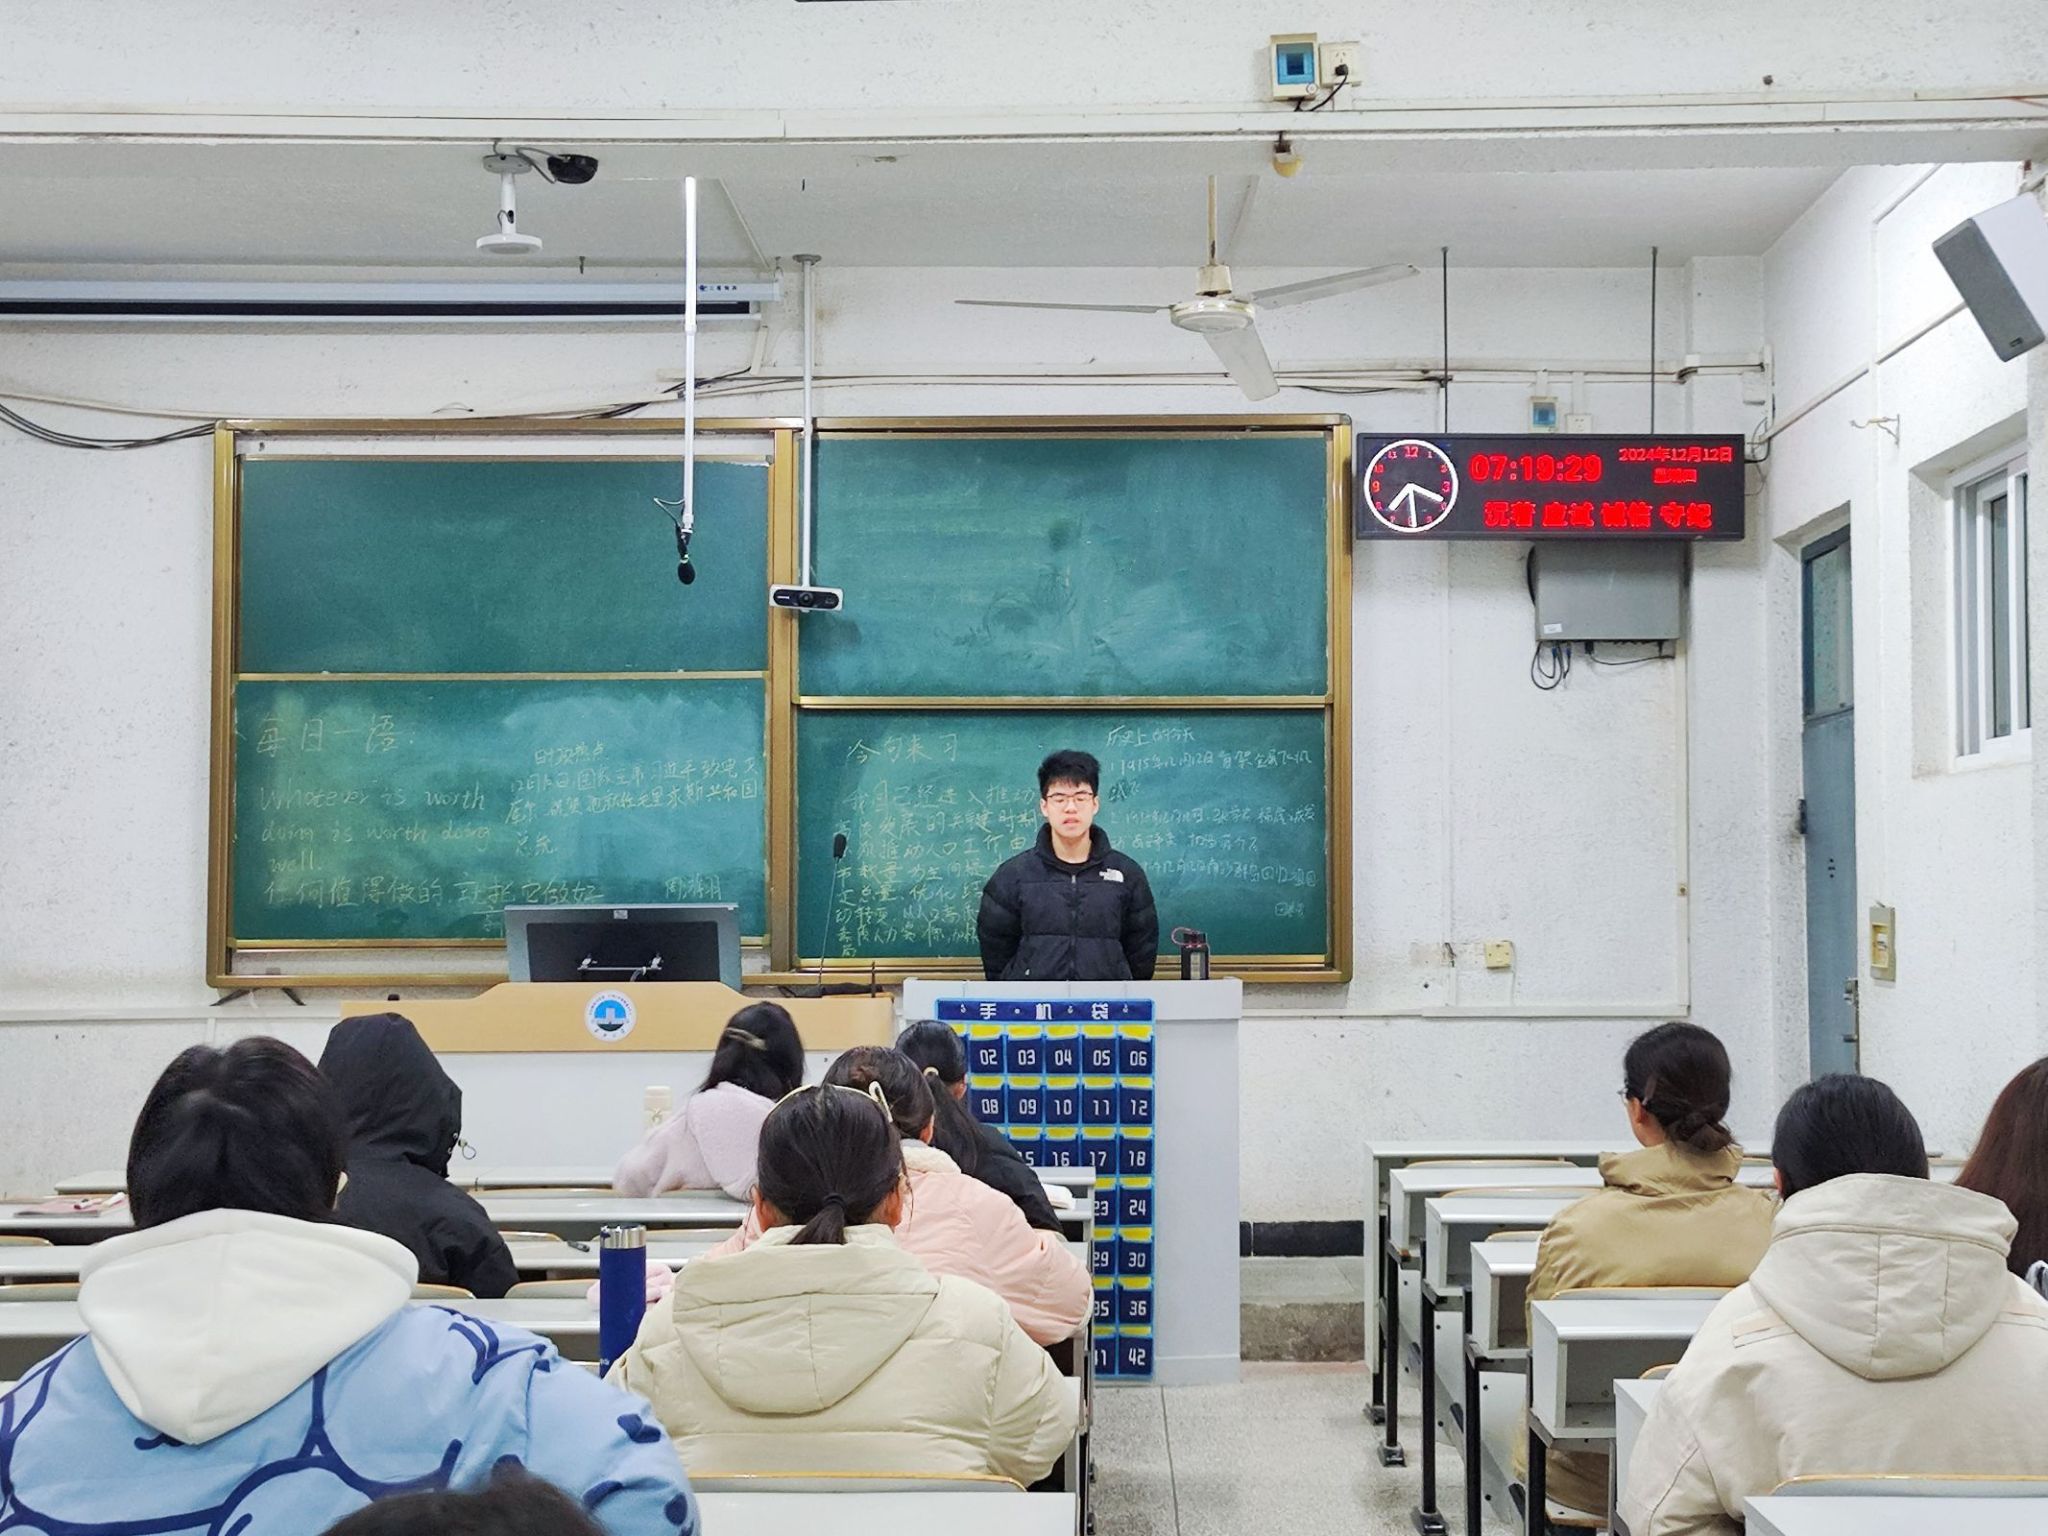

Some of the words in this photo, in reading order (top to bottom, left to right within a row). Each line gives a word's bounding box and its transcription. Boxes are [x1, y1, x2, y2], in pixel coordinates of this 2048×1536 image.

[1404, 446, 1419, 458] 12
[1619, 446, 1733, 462] 2024年12月12日
[1470, 454, 1602, 482] 07:19:29
[1372, 480, 1380, 492] 9
[1441, 480, 1451, 493] 3
[1660, 501, 1712, 529] 守纪
[380, 786, 408, 806] is
[425, 780, 487, 811] worth
[330, 820, 353, 843] is
[367, 821, 429, 843] worth
[442, 820, 491, 852] doing
[979, 1049, 998, 1066] 02
[1018, 1049, 1036, 1066] 03
[1054, 1049, 1073, 1066] 04
[1093, 1049, 1111, 1066] 05
[1129, 1050, 1147, 1066] 06
[981, 1098, 999, 1115] 08
[1019, 1098, 1037, 1115] 09
[1054, 1099, 1072, 1115] 10
[1093, 1099, 1110, 1116] 11
[1130, 1099, 1148, 1116] 12
[1052, 1151, 1070, 1167] 16
[1089, 1151, 1107, 1167] 17
[1129, 1151, 1146, 1167] 18
[1129, 1199, 1146, 1216] 24
[1128, 1252, 1146, 1268] 30
[1129, 1300, 1147, 1316] 36
[1128, 1348, 1146, 1366] 42
